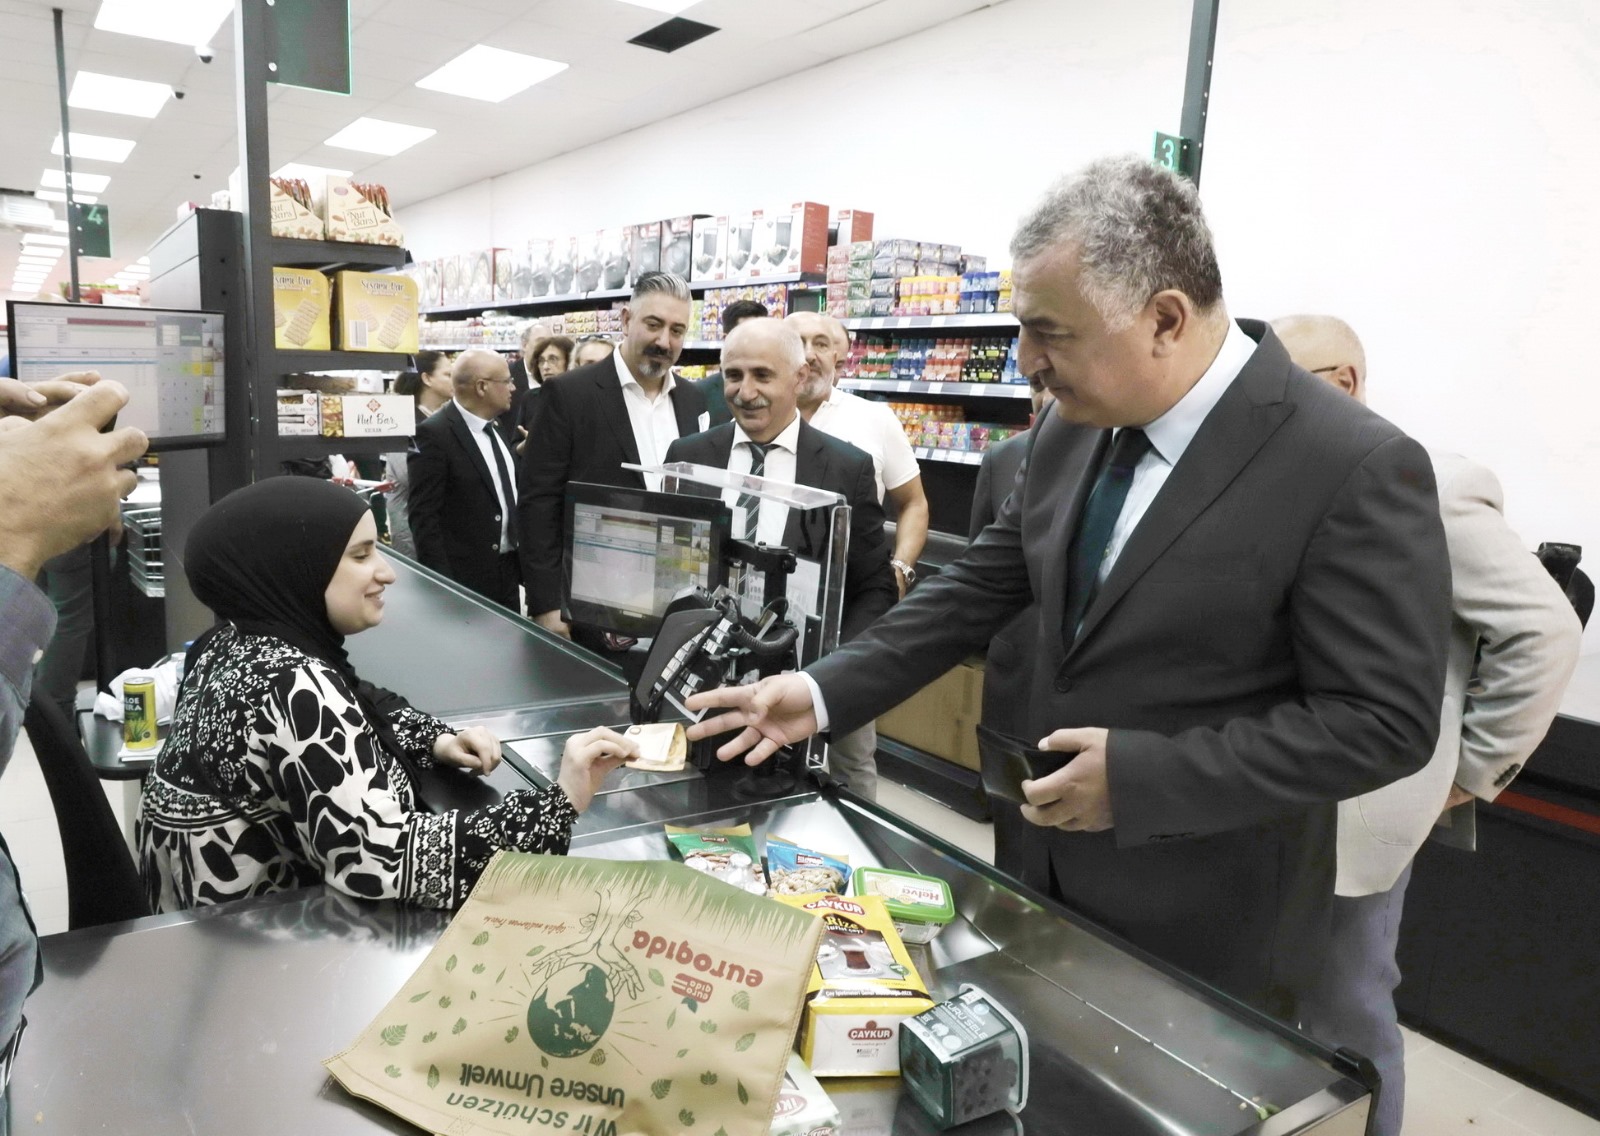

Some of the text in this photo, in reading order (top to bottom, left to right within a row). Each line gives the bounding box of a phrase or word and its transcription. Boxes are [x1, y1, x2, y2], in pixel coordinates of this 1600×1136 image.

[1160, 139, 1175, 170] 3
[88, 205, 103, 225] 4
[357, 413, 397, 427] Nut Bar
[902, 887, 940, 901] Helva
[806, 900, 863, 915] ÇAYKUR
[826, 915, 860, 930] Rize
[943, 1001, 968, 1020] KURU
[850, 1029, 891, 1040] ÇAYKUR
[459, 1063, 625, 1109] unsere Umwelt
[446, 1092, 618, 1136] Wir schützen
